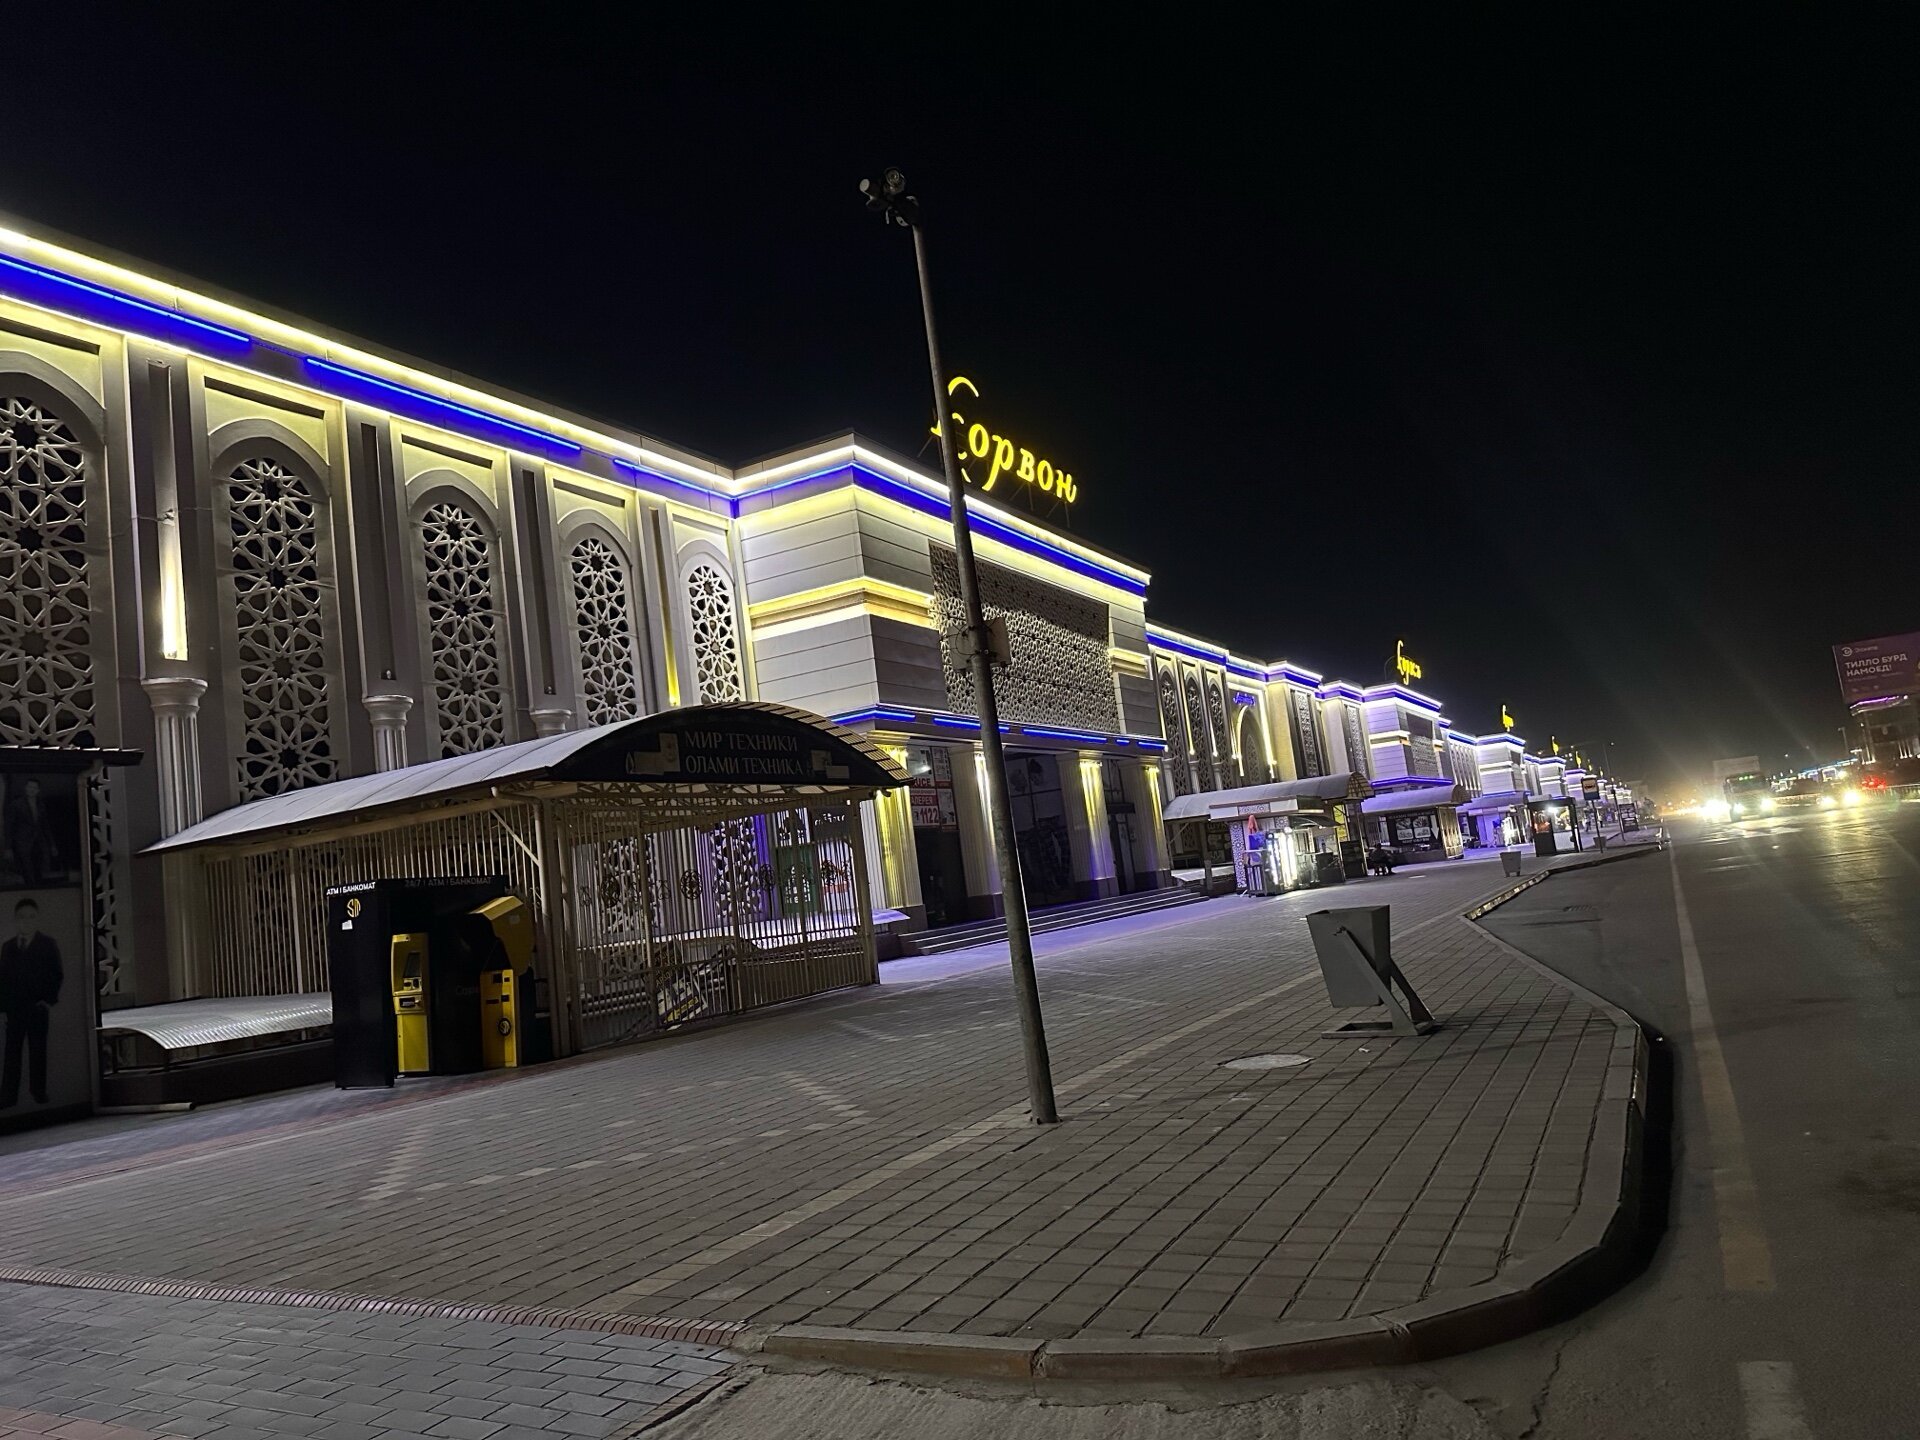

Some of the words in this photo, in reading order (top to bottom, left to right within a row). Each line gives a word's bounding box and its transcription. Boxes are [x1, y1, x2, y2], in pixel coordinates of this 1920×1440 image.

[1844, 657, 1879, 668] ТИЛЛО
[1881, 653, 1907, 663] БУРД
[685, 731, 722, 749] МИР
[726, 732, 798, 752] ТЕХНИКИ
[685, 754, 740, 774] ОЛАМИ
[742, 757, 804, 775] ТЕХНИКА
[920, 807, 939, 824] 1122
[326, 887, 339, 896] ATM
[343, 881, 376, 894] БАНКОМАТ
